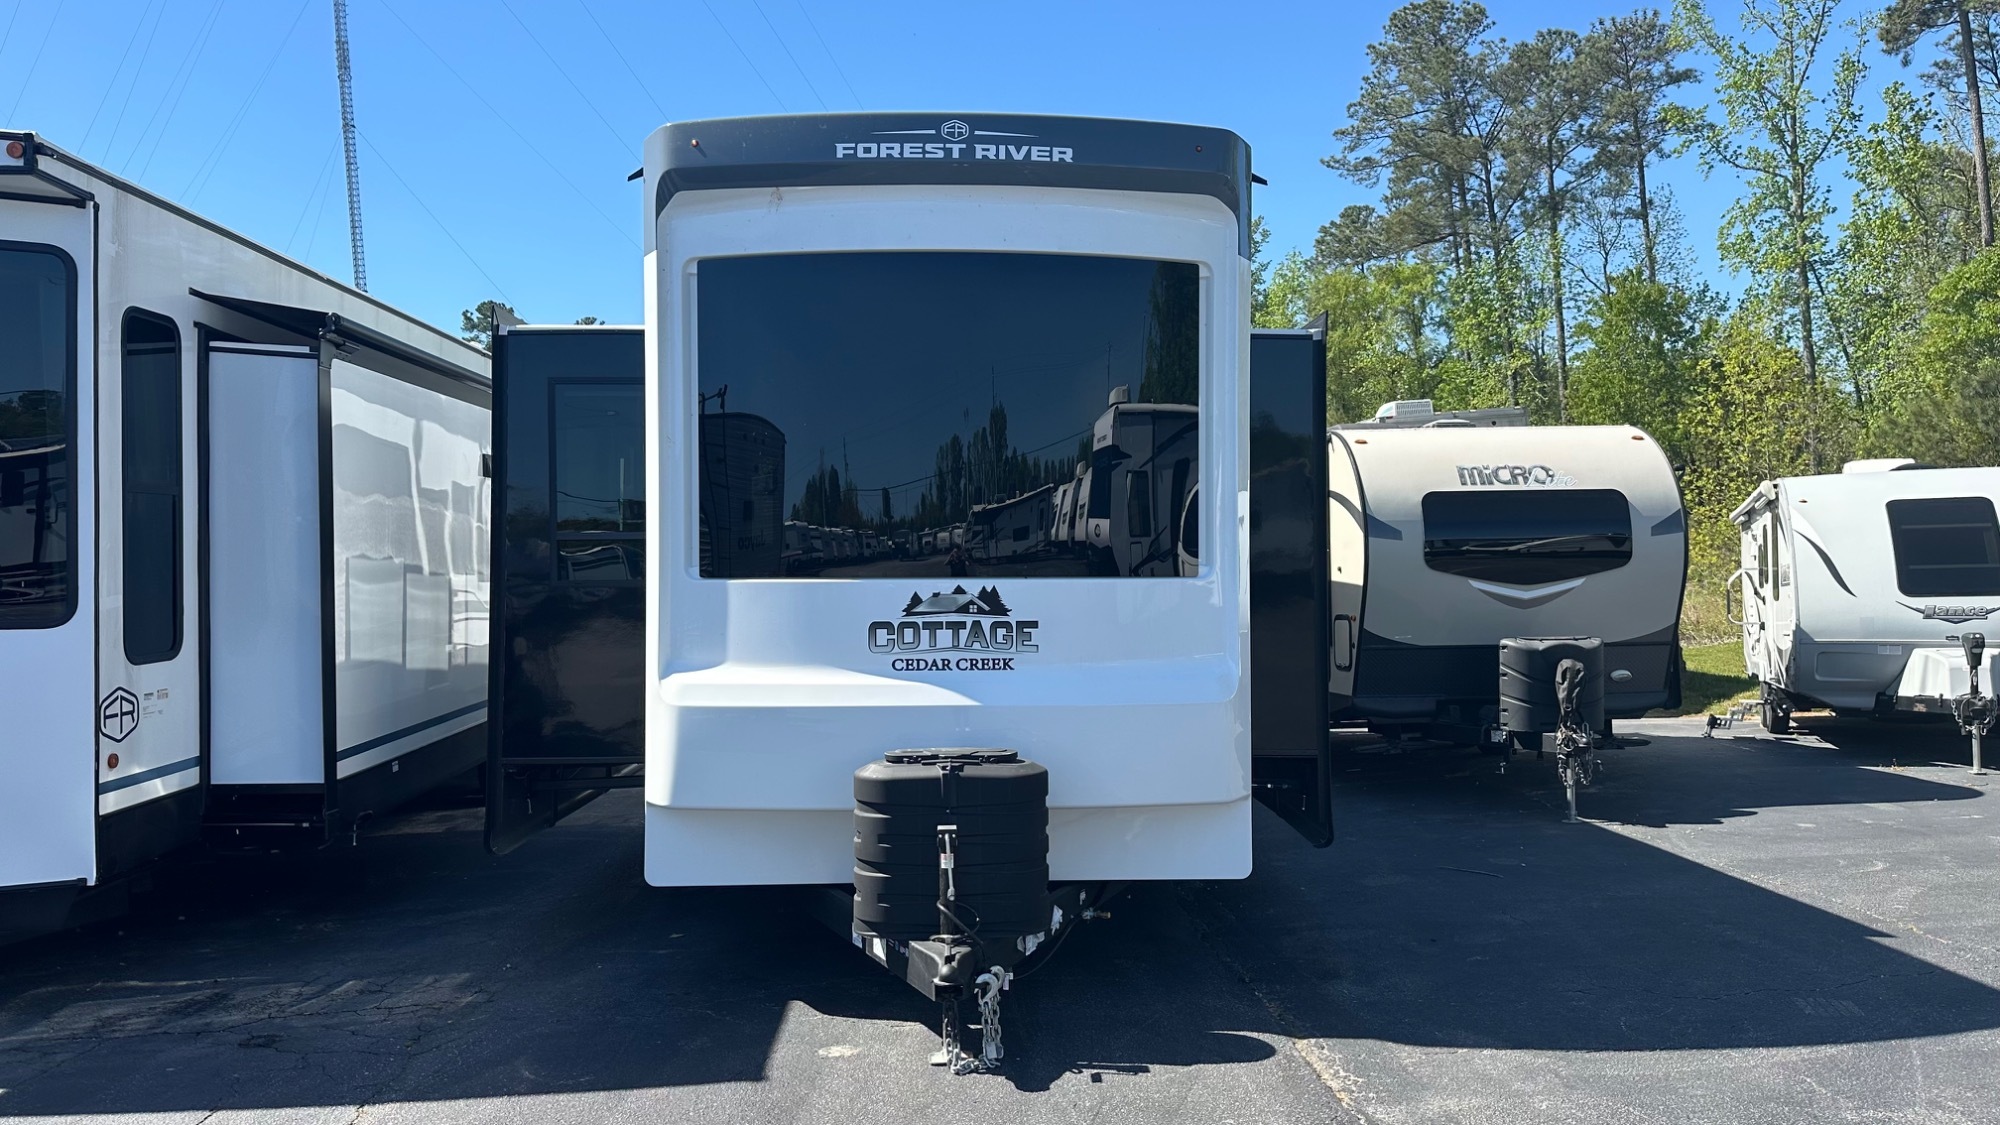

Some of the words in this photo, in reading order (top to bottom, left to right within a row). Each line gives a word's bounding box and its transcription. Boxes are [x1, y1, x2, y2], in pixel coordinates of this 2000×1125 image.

[835, 143, 966, 159] FOREST
[973, 143, 1073, 162] RIVER
[1923, 604, 1988, 619] Lance
[868, 620, 1039, 653] COTTAGE
[892, 658, 952, 671] CEDAR
[955, 657, 1014, 671] CREEK
